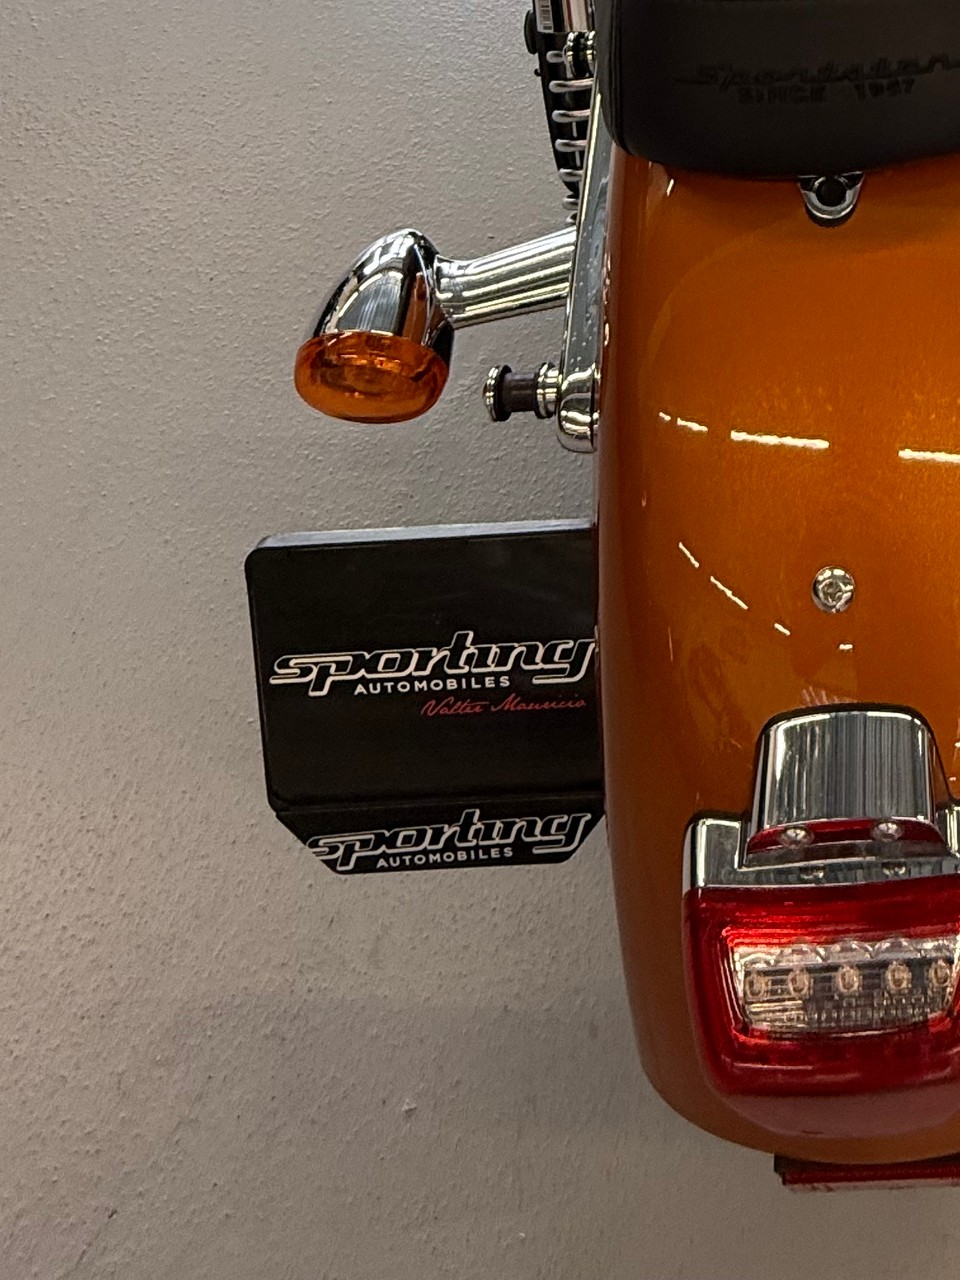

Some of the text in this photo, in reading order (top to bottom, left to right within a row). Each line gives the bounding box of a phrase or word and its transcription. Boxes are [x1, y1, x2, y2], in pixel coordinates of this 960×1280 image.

[269, 630, 596, 697] sporting
[354, 675, 510, 695] AUTOMOBILES
[306, 809, 592, 871] sporting
[376, 847, 513, 868] AUTOMOBILES
